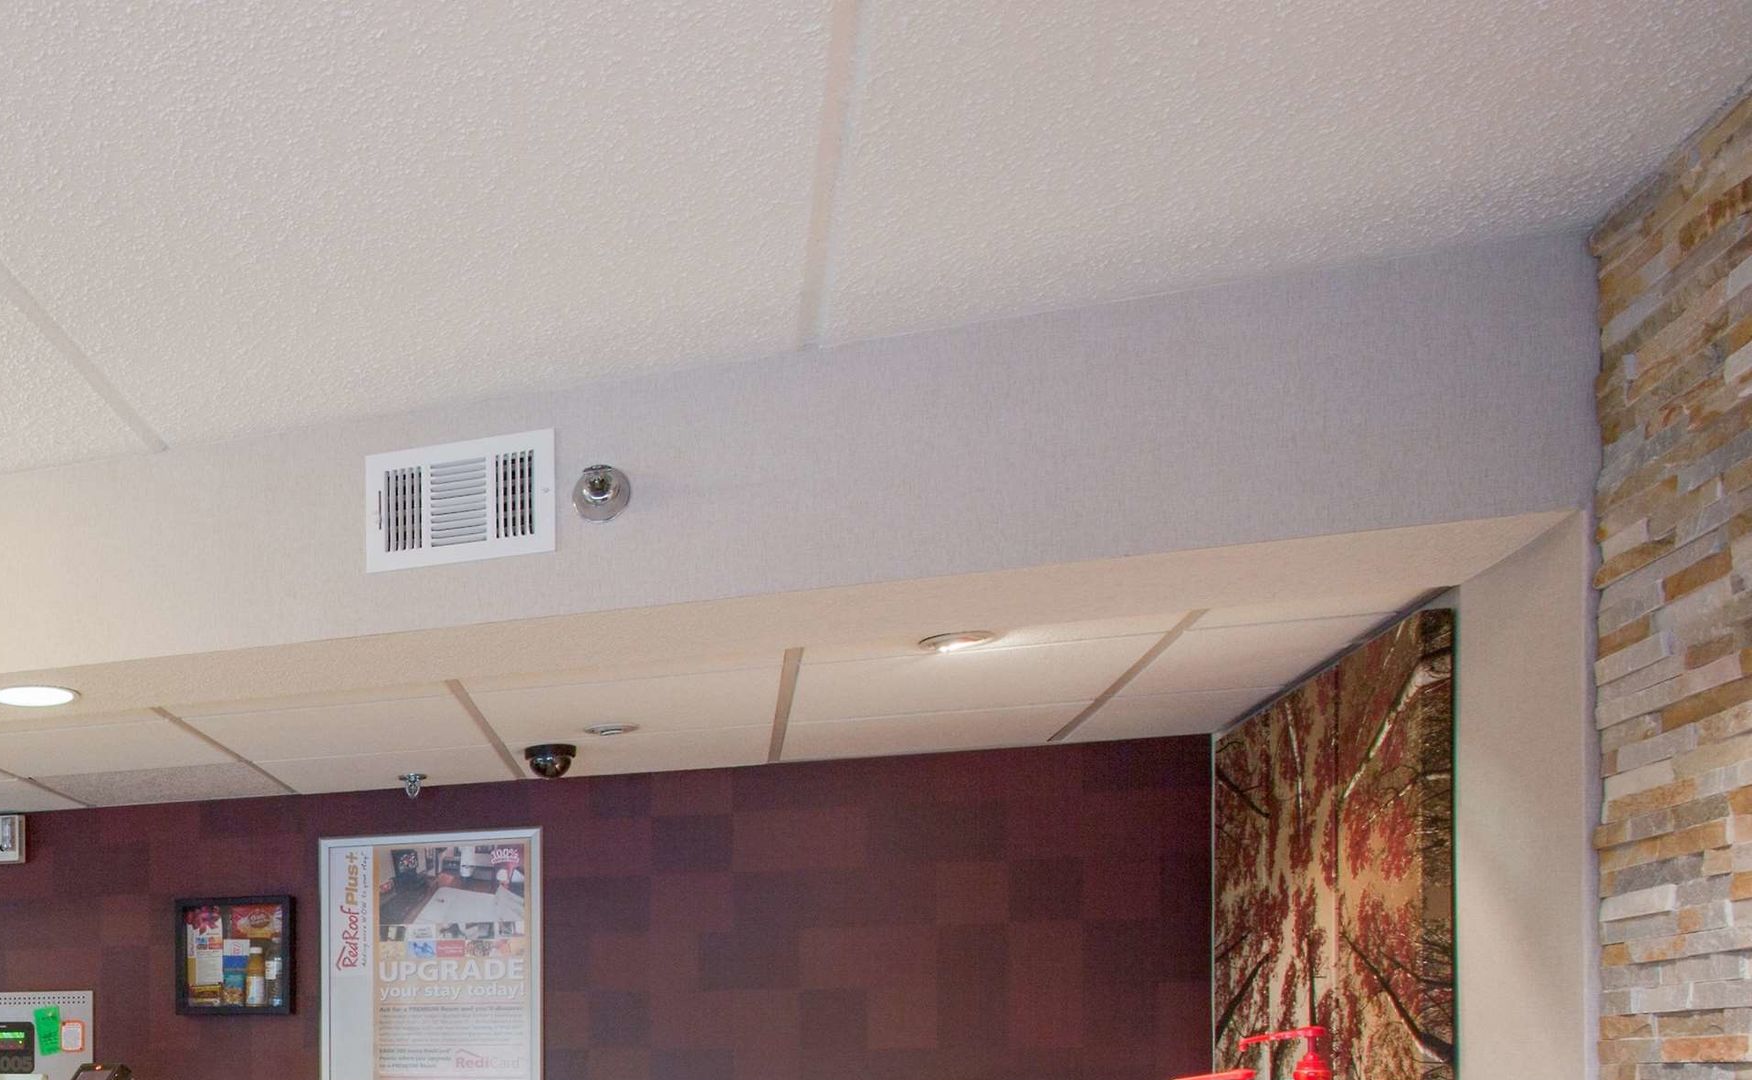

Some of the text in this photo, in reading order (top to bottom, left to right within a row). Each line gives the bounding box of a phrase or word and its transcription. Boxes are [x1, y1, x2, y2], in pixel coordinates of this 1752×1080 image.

[378, 958, 525, 982] UPGRADE
[380, 982, 525, 1001] your stay today!
